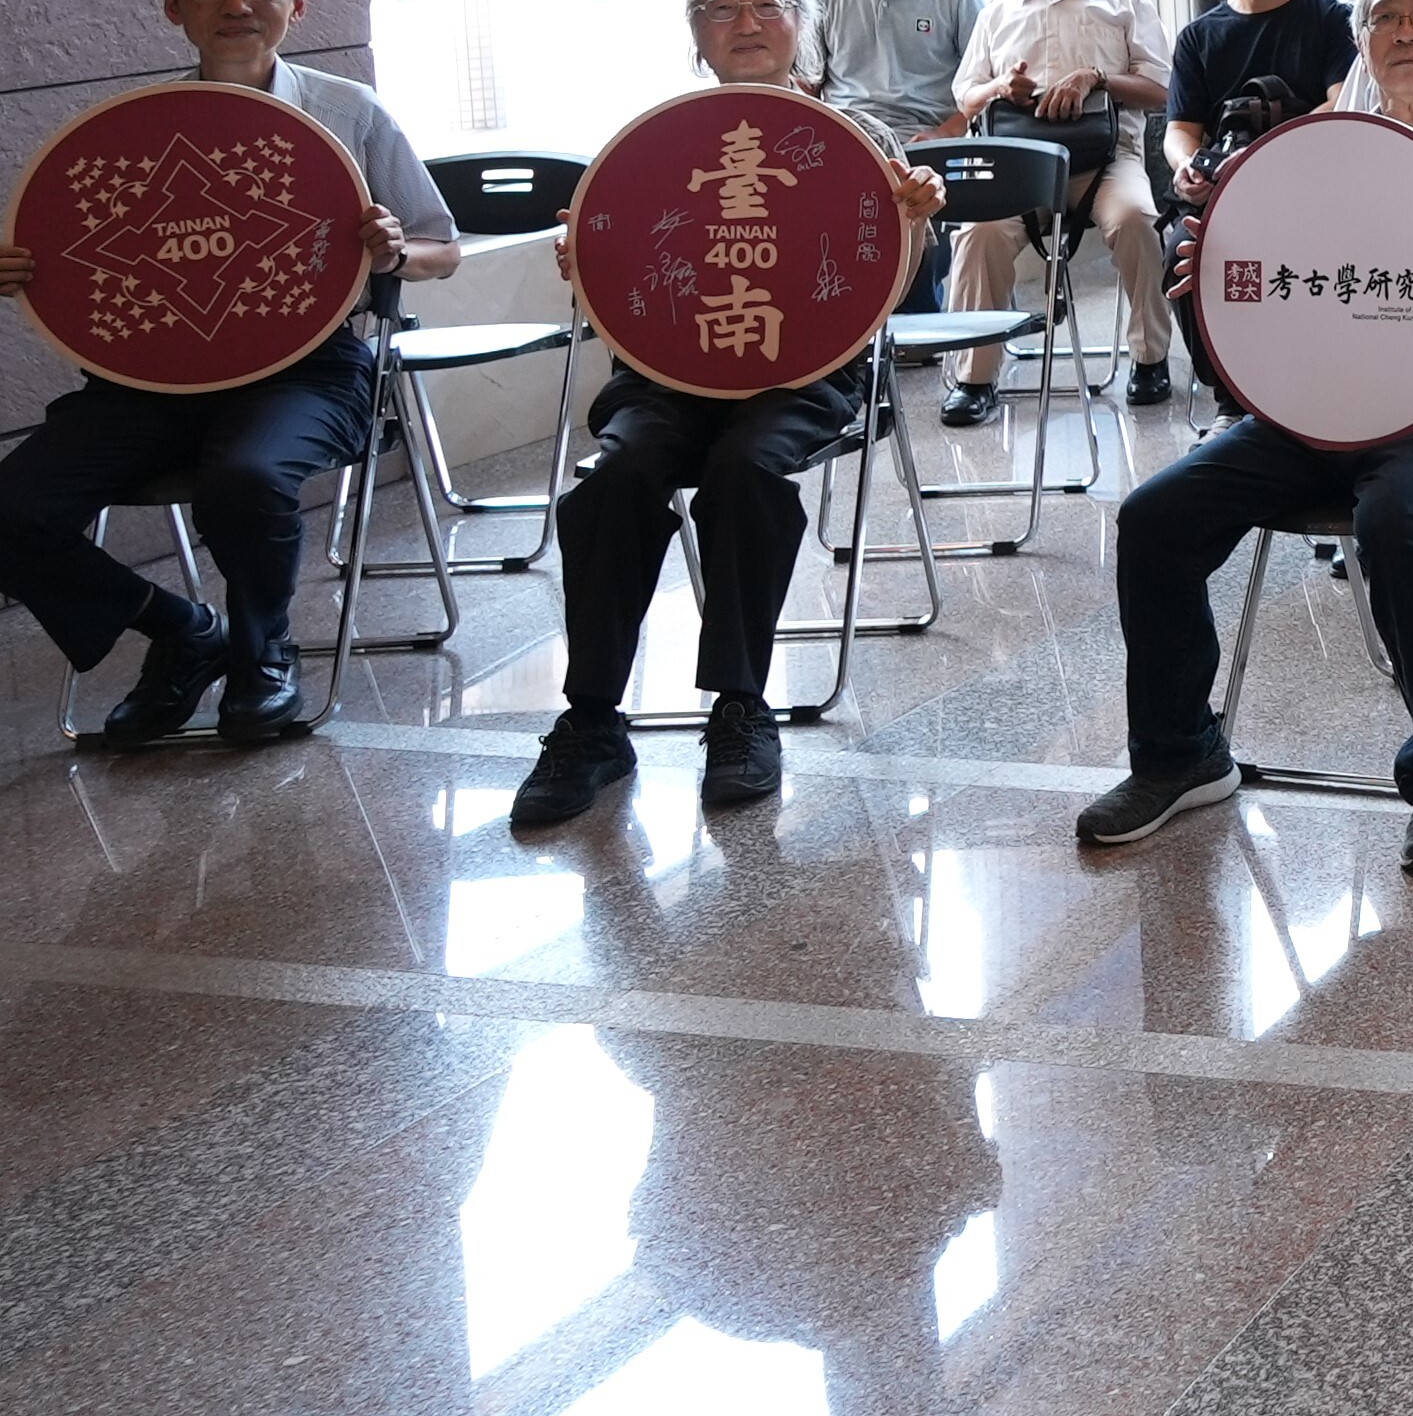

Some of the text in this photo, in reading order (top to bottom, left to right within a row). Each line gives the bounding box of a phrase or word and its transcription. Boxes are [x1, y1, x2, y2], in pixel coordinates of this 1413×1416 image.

[687, 119, 798, 219] 臺
[152, 214, 231, 237] TAINAN
[705, 225, 777, 240] TAINAN
[156, 231, 235, 263] 400
[704, 242, 778, 269] 400
[694, 274, 785, 362] 南
